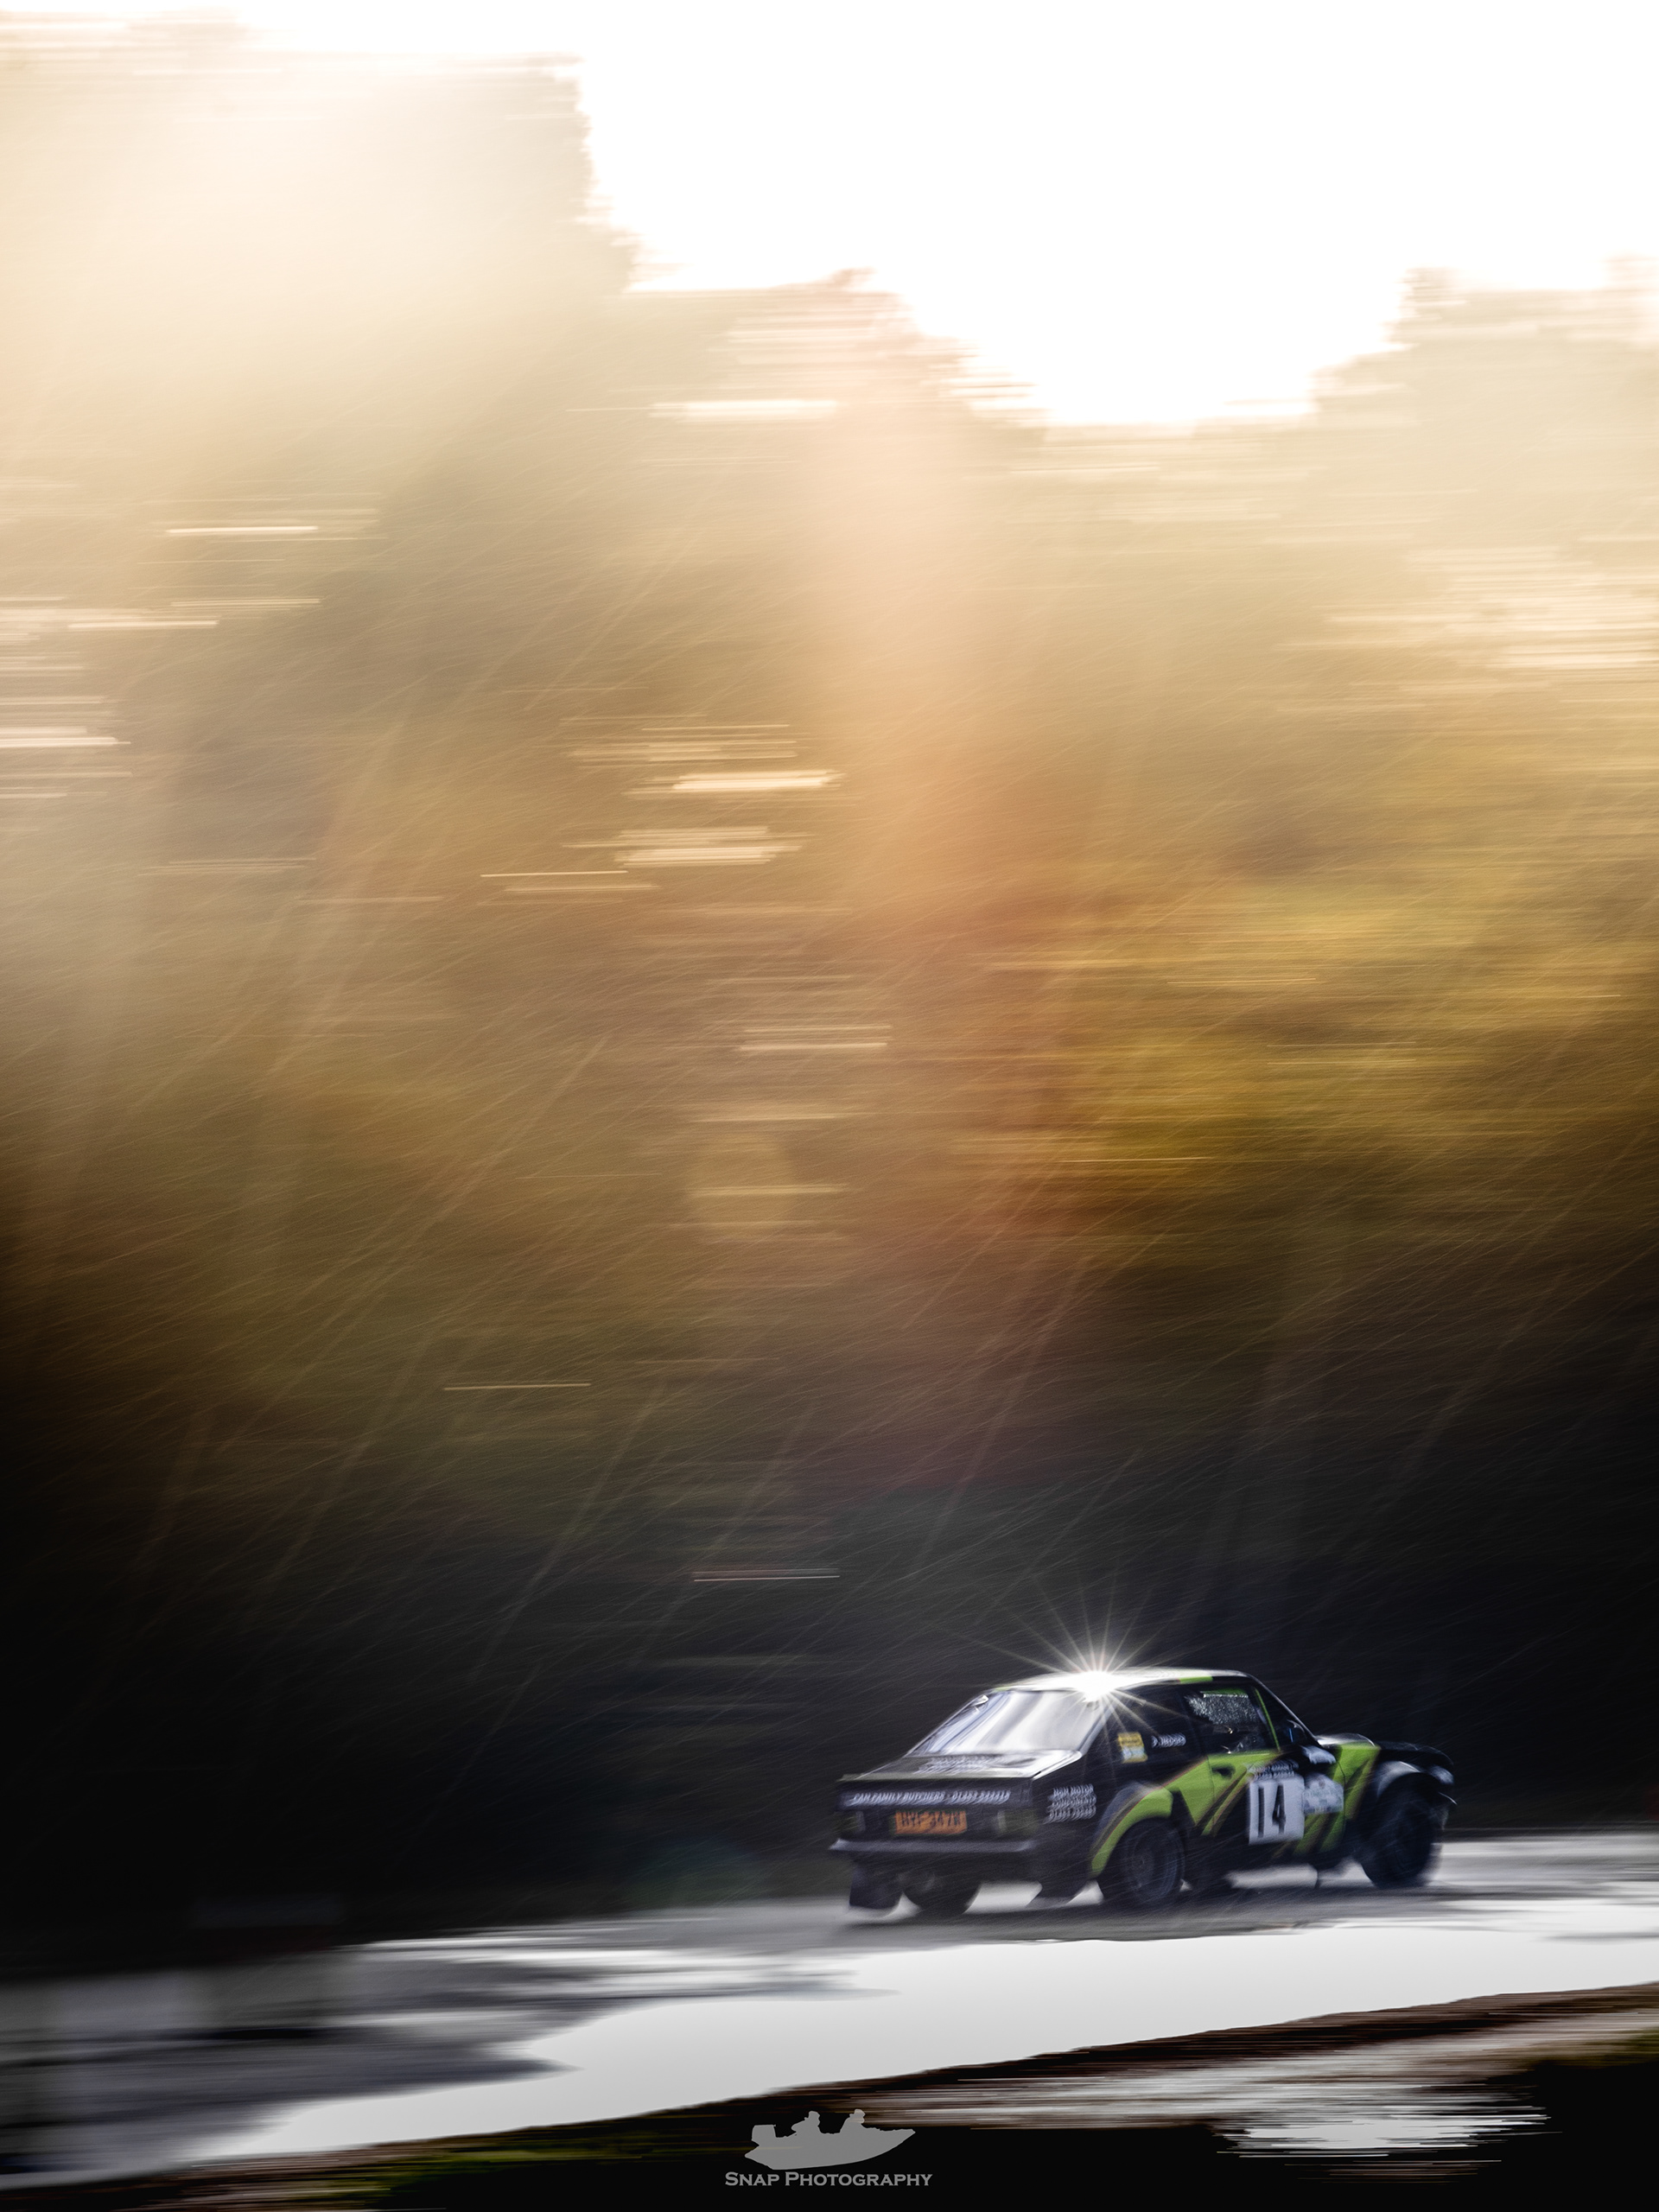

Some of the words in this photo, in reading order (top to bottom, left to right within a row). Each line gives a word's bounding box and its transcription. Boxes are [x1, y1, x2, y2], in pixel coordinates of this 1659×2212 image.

[871, 1792, 902, 1804] FAMILY
[900, 1791, 945, 1804] BUTCHERS
[1257, 1785, 1286, 1838] 14
